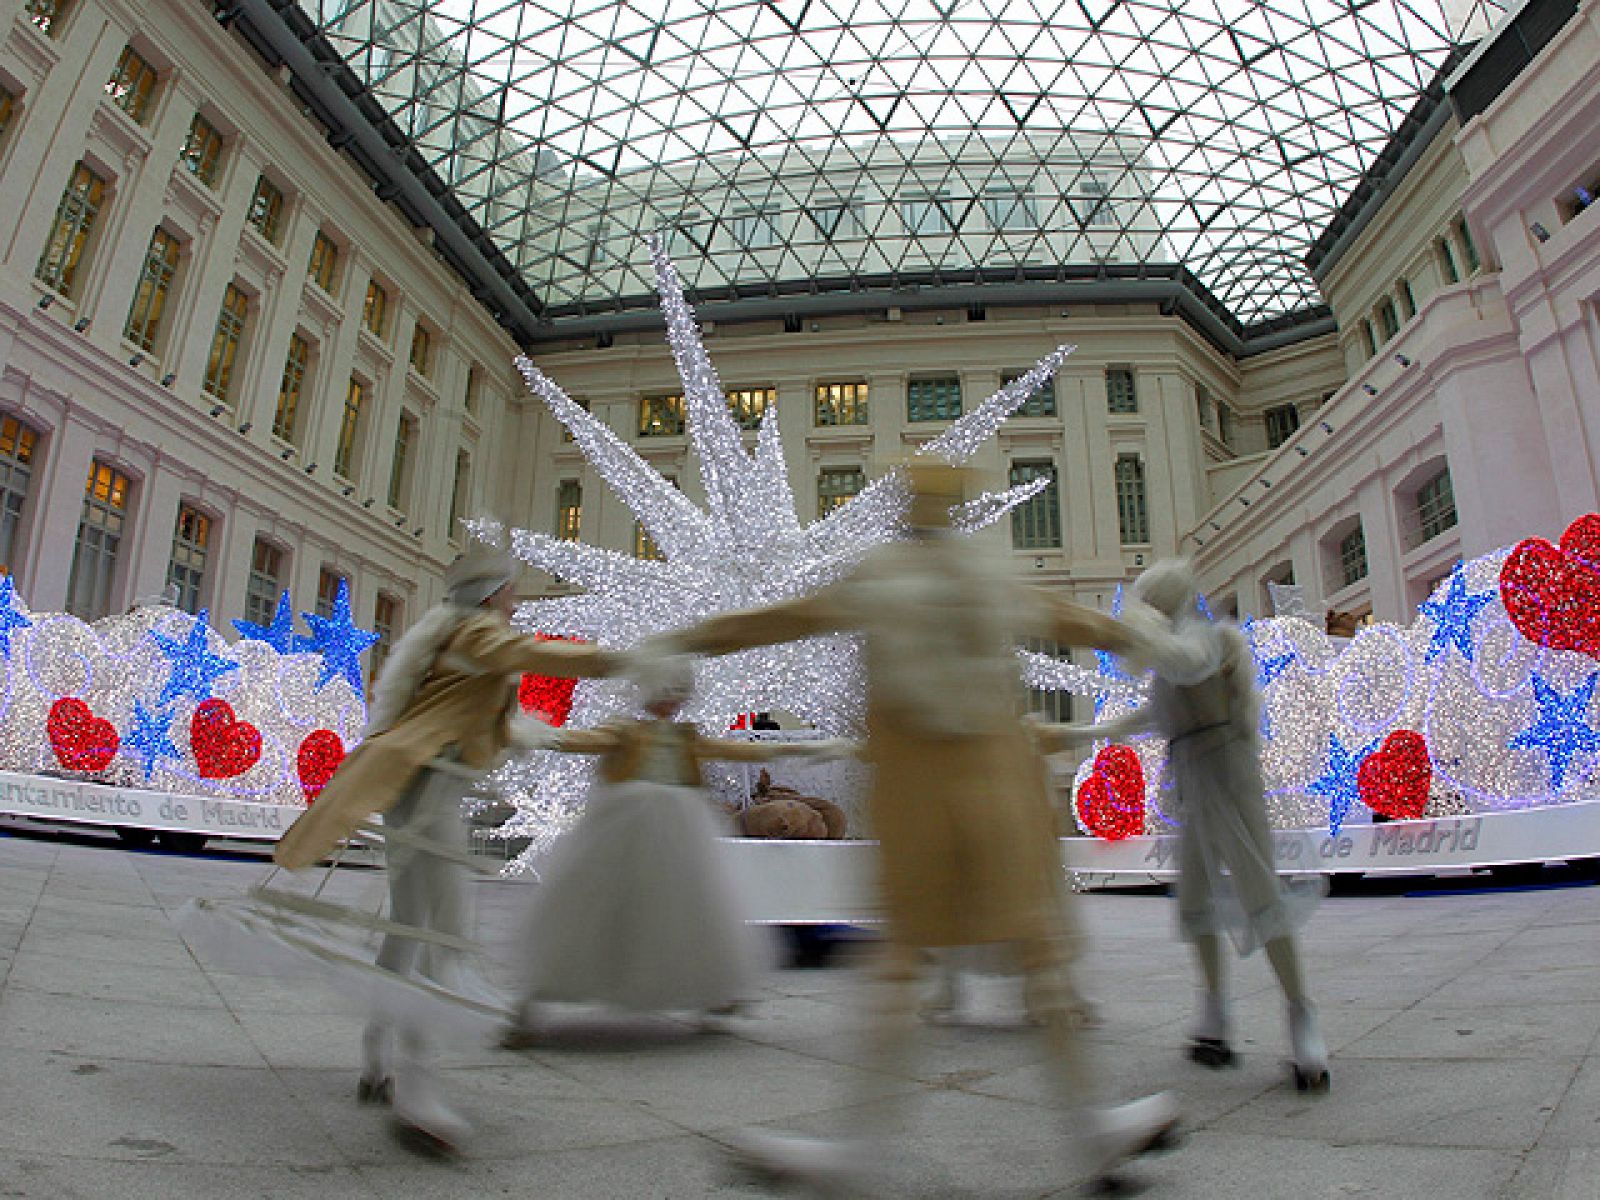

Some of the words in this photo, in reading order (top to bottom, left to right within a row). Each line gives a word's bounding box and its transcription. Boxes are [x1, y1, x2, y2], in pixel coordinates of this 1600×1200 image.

[0, 781, 141, 817] ntamiento
[160, 797, 188, 820] de
[203, 801, 282, 829] Madrid
[1320, 832, 1353, 858] de
[1370, 817, 1482, 857] Madrid
